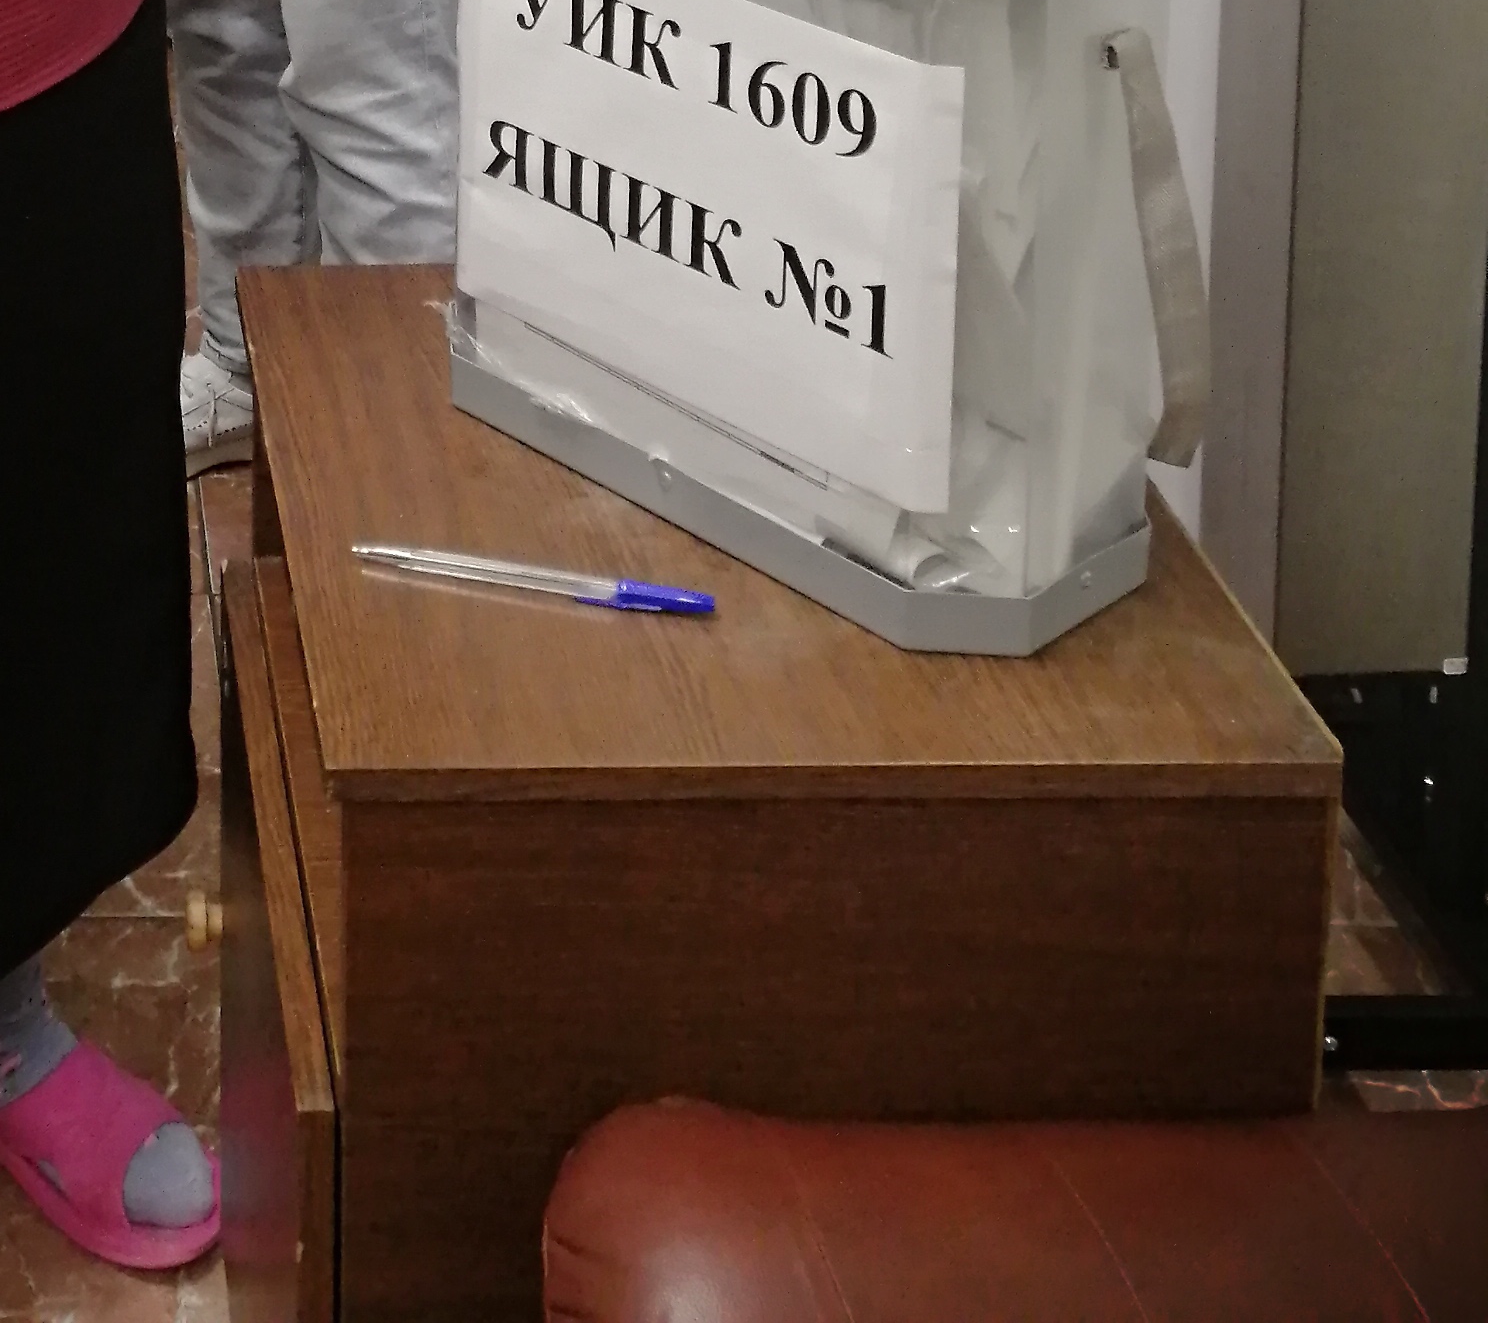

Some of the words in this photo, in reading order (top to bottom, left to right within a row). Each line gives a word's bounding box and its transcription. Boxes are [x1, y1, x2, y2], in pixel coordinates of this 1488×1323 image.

[707, 40, 878, 158] 1609
[482, 119, 743, 291] ЯЩИК
[763, 237, 894, 360] №1
